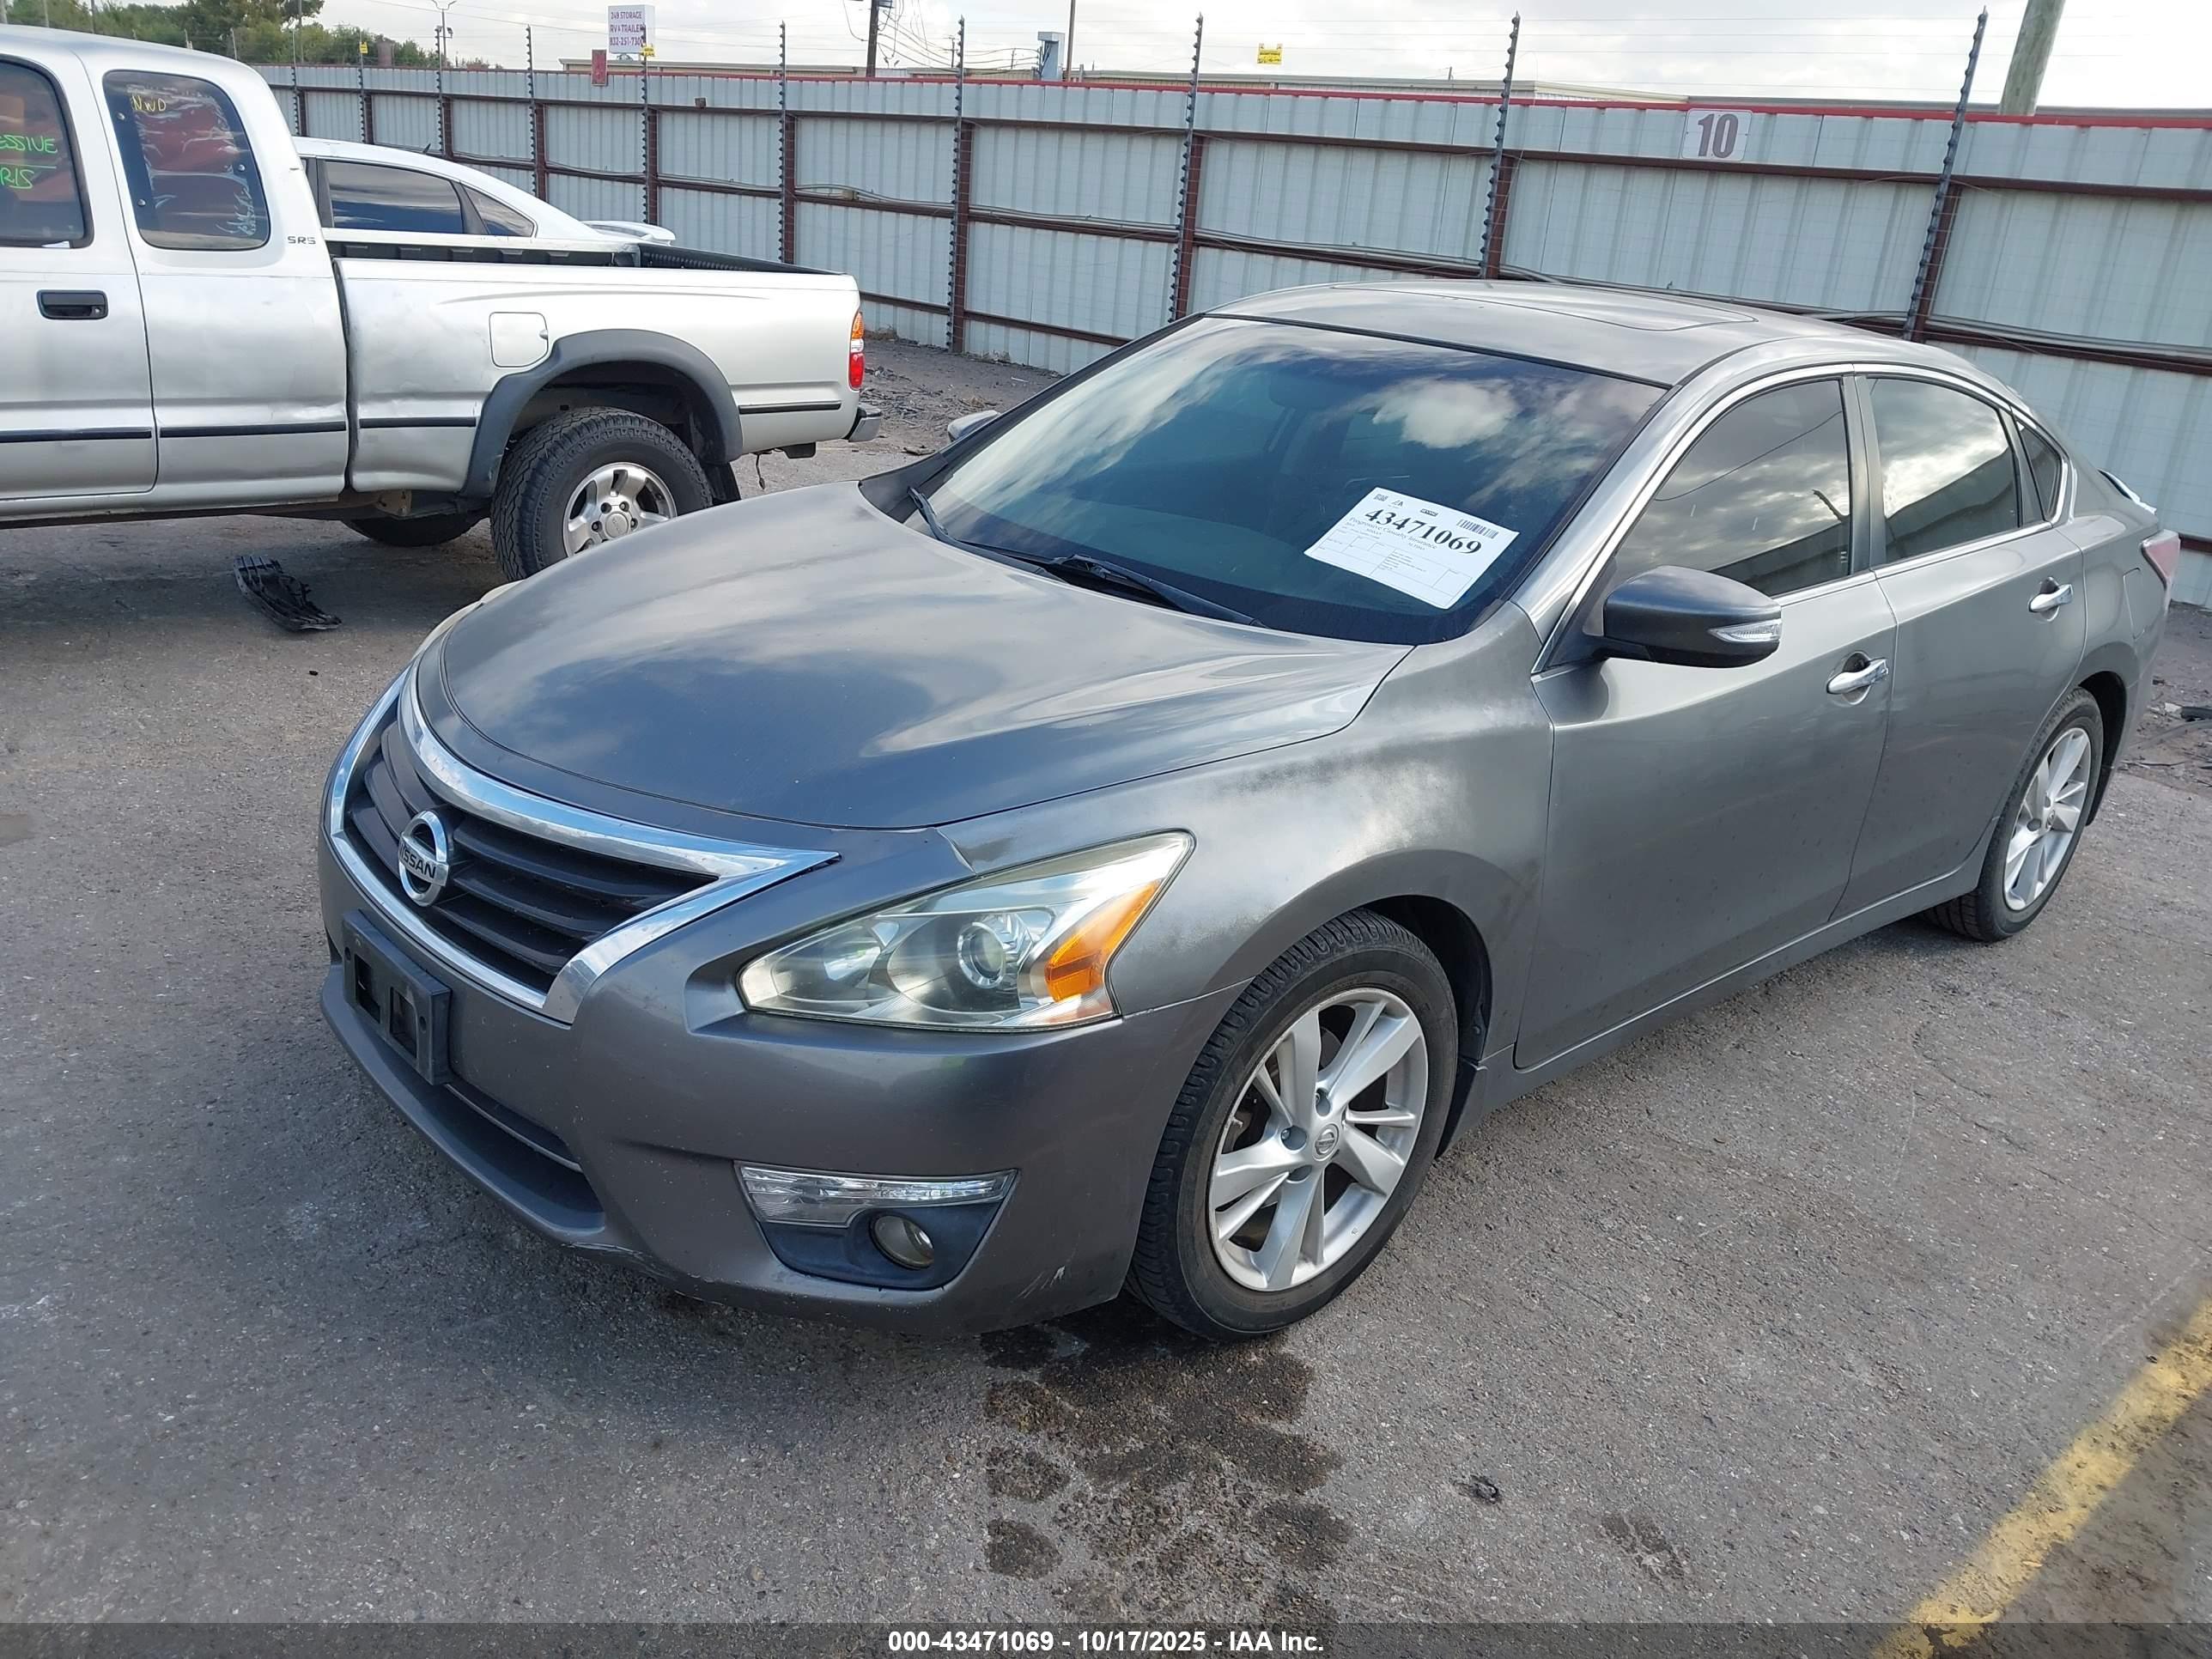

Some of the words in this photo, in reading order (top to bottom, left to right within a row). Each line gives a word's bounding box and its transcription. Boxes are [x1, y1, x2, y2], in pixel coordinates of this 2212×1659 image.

[611, 11, 619, 20] 249
[610, 24, 617, 33] RV
[1698, 113, 1739, 158] 10
[288, 235, 316, 245] SR5
[1364, 508, 1482, 554] 43471069
[398, 842, 436, 878] NISSAN
